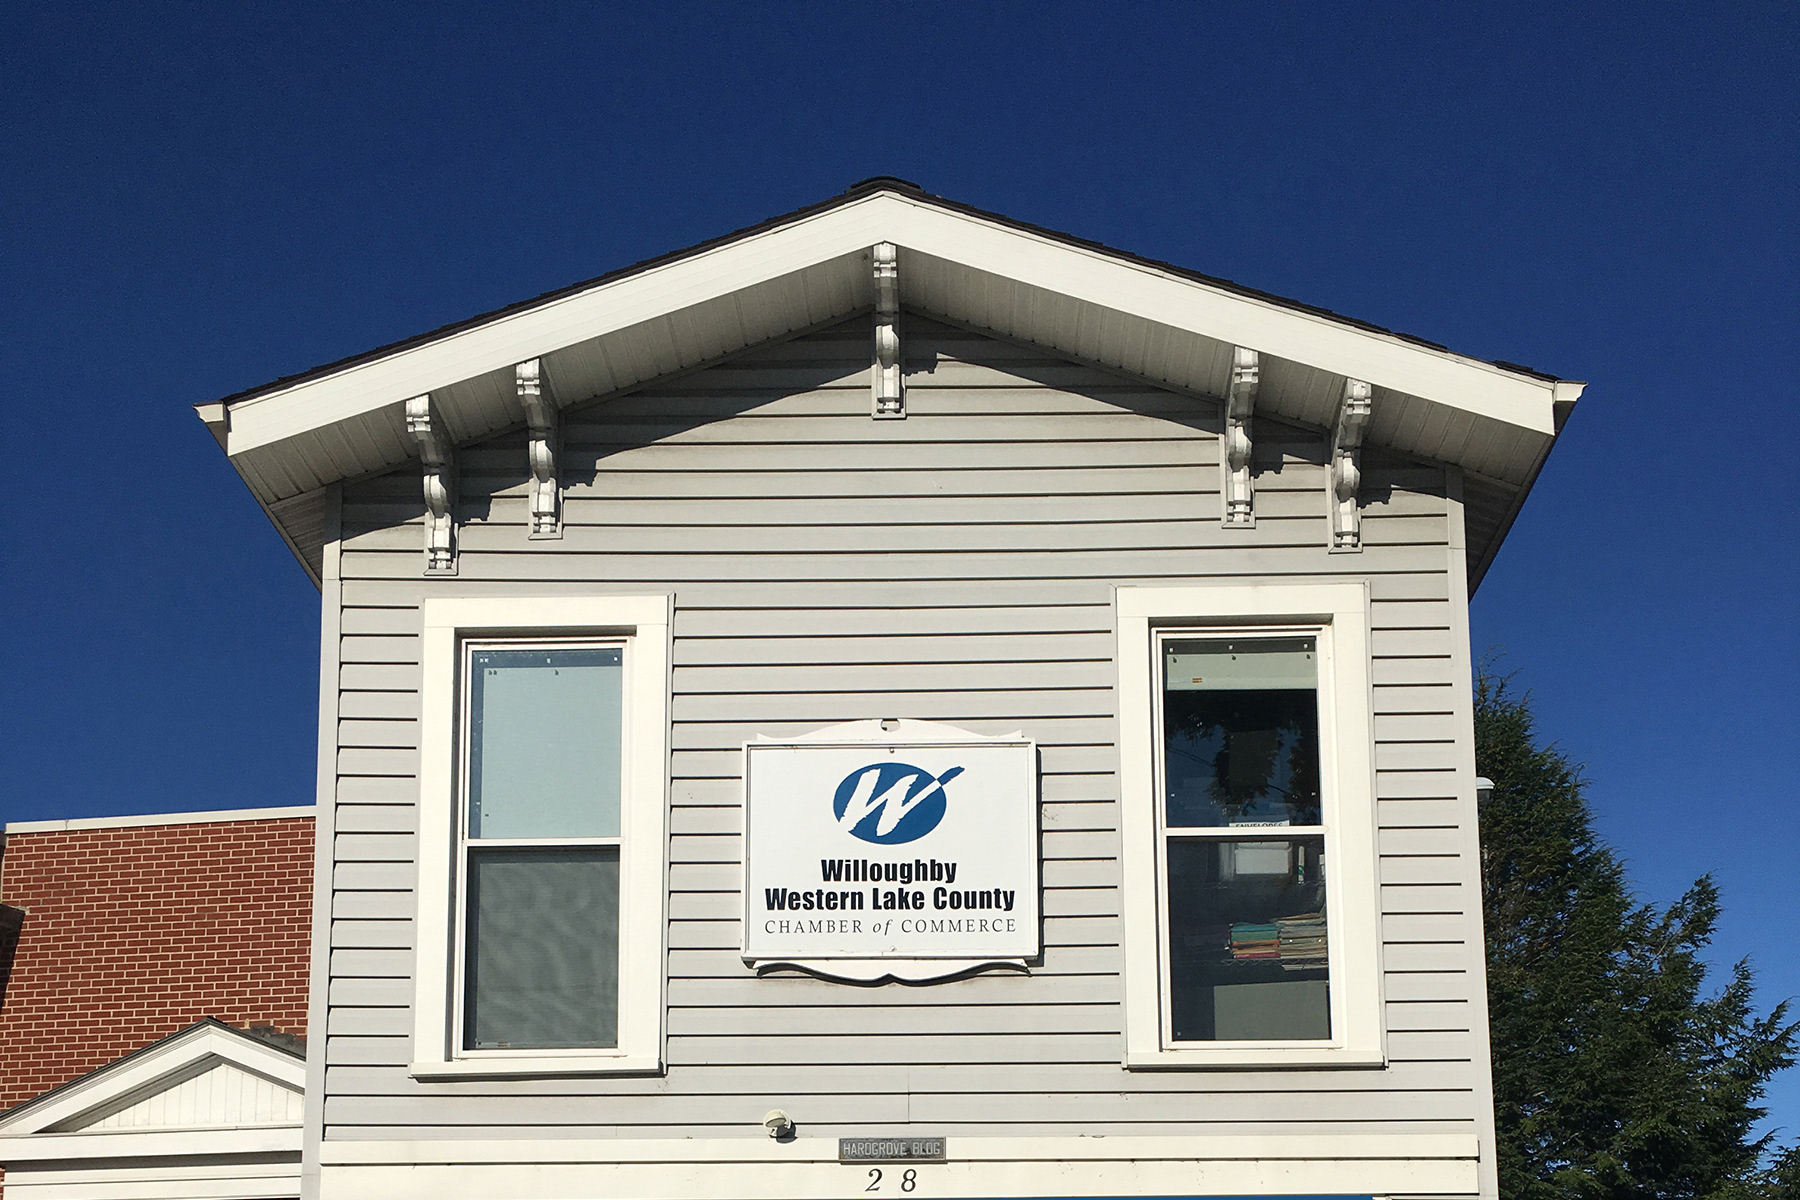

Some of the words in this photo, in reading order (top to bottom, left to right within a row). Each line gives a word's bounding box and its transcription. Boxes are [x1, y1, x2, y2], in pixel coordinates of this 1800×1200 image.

[821, 859, 957, 884] Willoughby
[765, 888, 864, 911] Western
[872, 887, 925, 910] Lake
[933, 886, 1015, 912] County
[764, 919, 863, 935] CHAMBER
[873, 918, 893, 936] of
[901, 918, 1016, 933] COMMERCE
